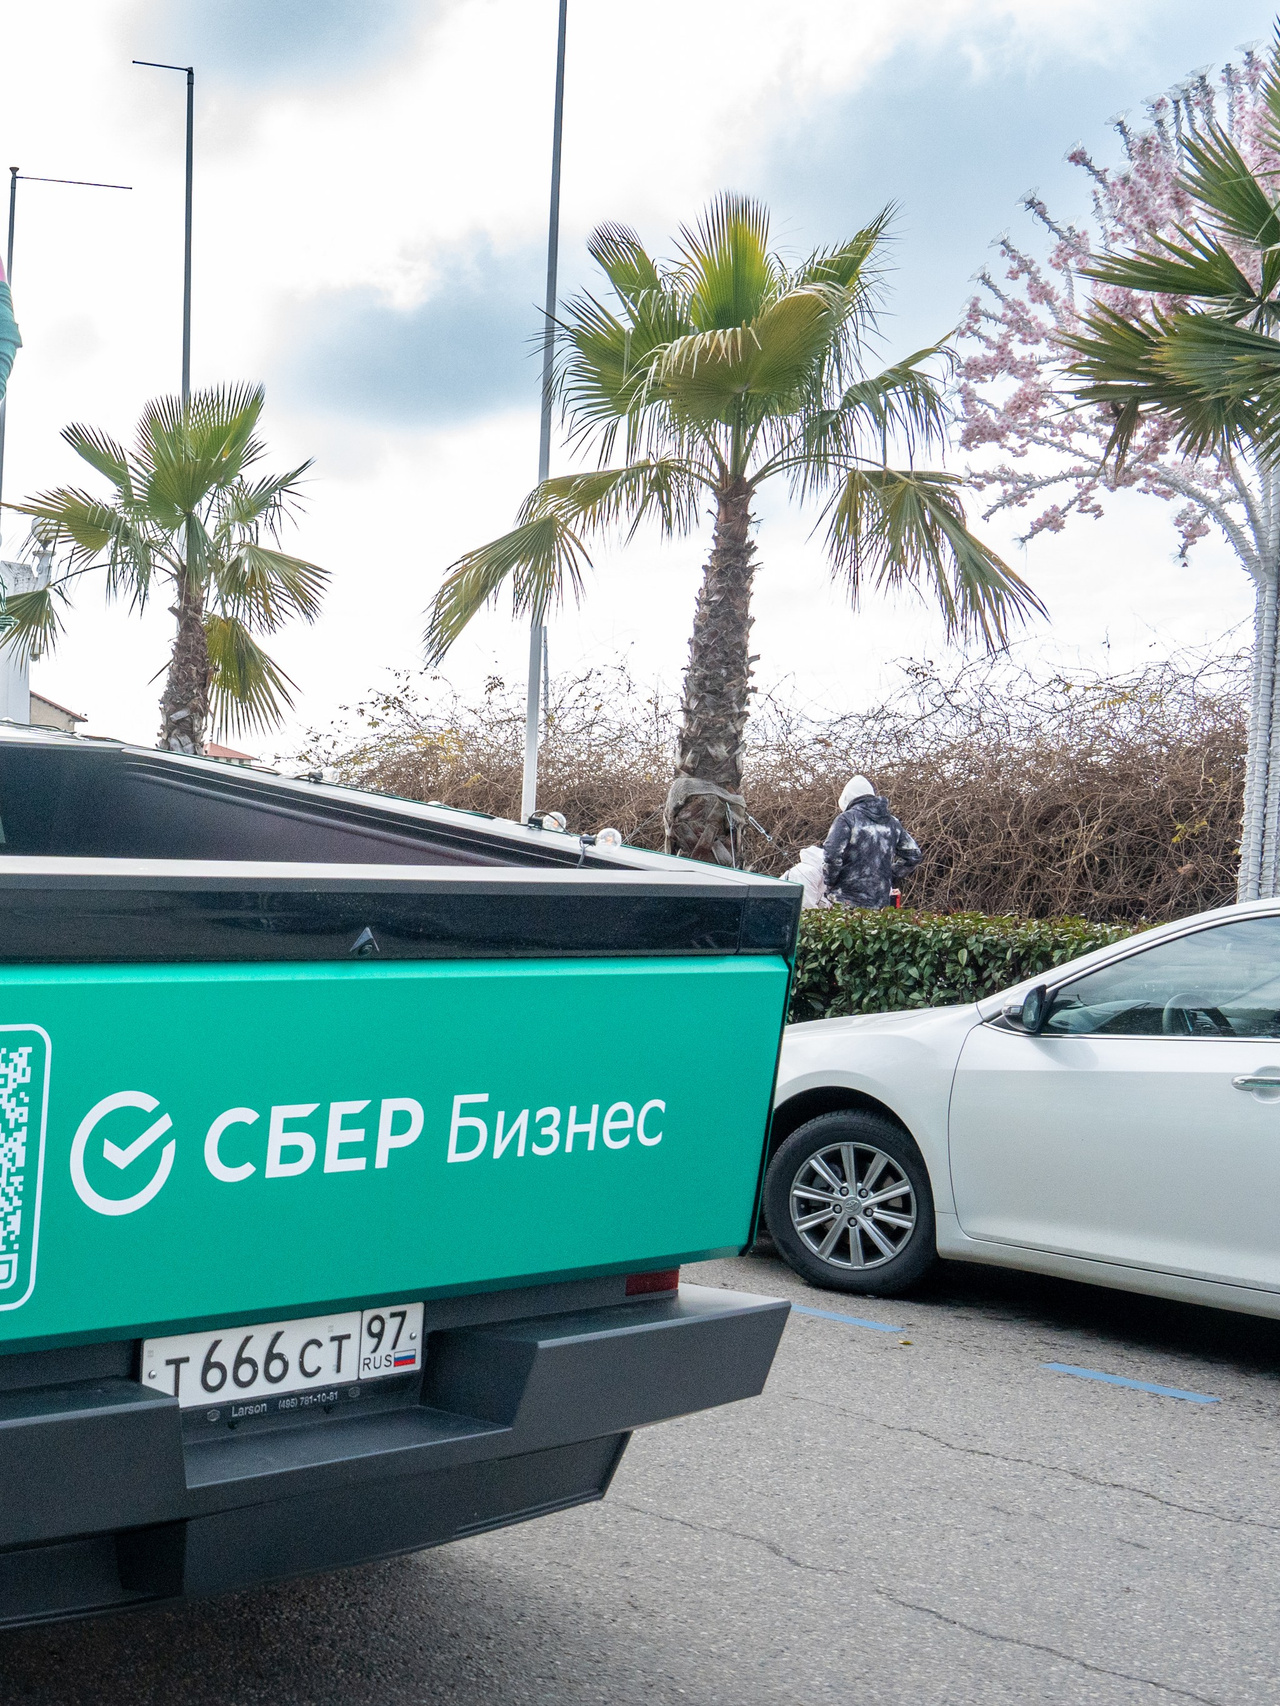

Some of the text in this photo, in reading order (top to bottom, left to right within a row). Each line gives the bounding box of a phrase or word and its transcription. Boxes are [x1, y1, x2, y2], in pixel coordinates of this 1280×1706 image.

[204, 1093, 666, 1182] СБЕР Бизнес
[165, 1310, 407, 1397] Т666СТ 97
[363, 1357, 393, 1372] RUS
[231, 1403, 267, 1418] Larson
[278, 1397, 298, 1410] (495)
